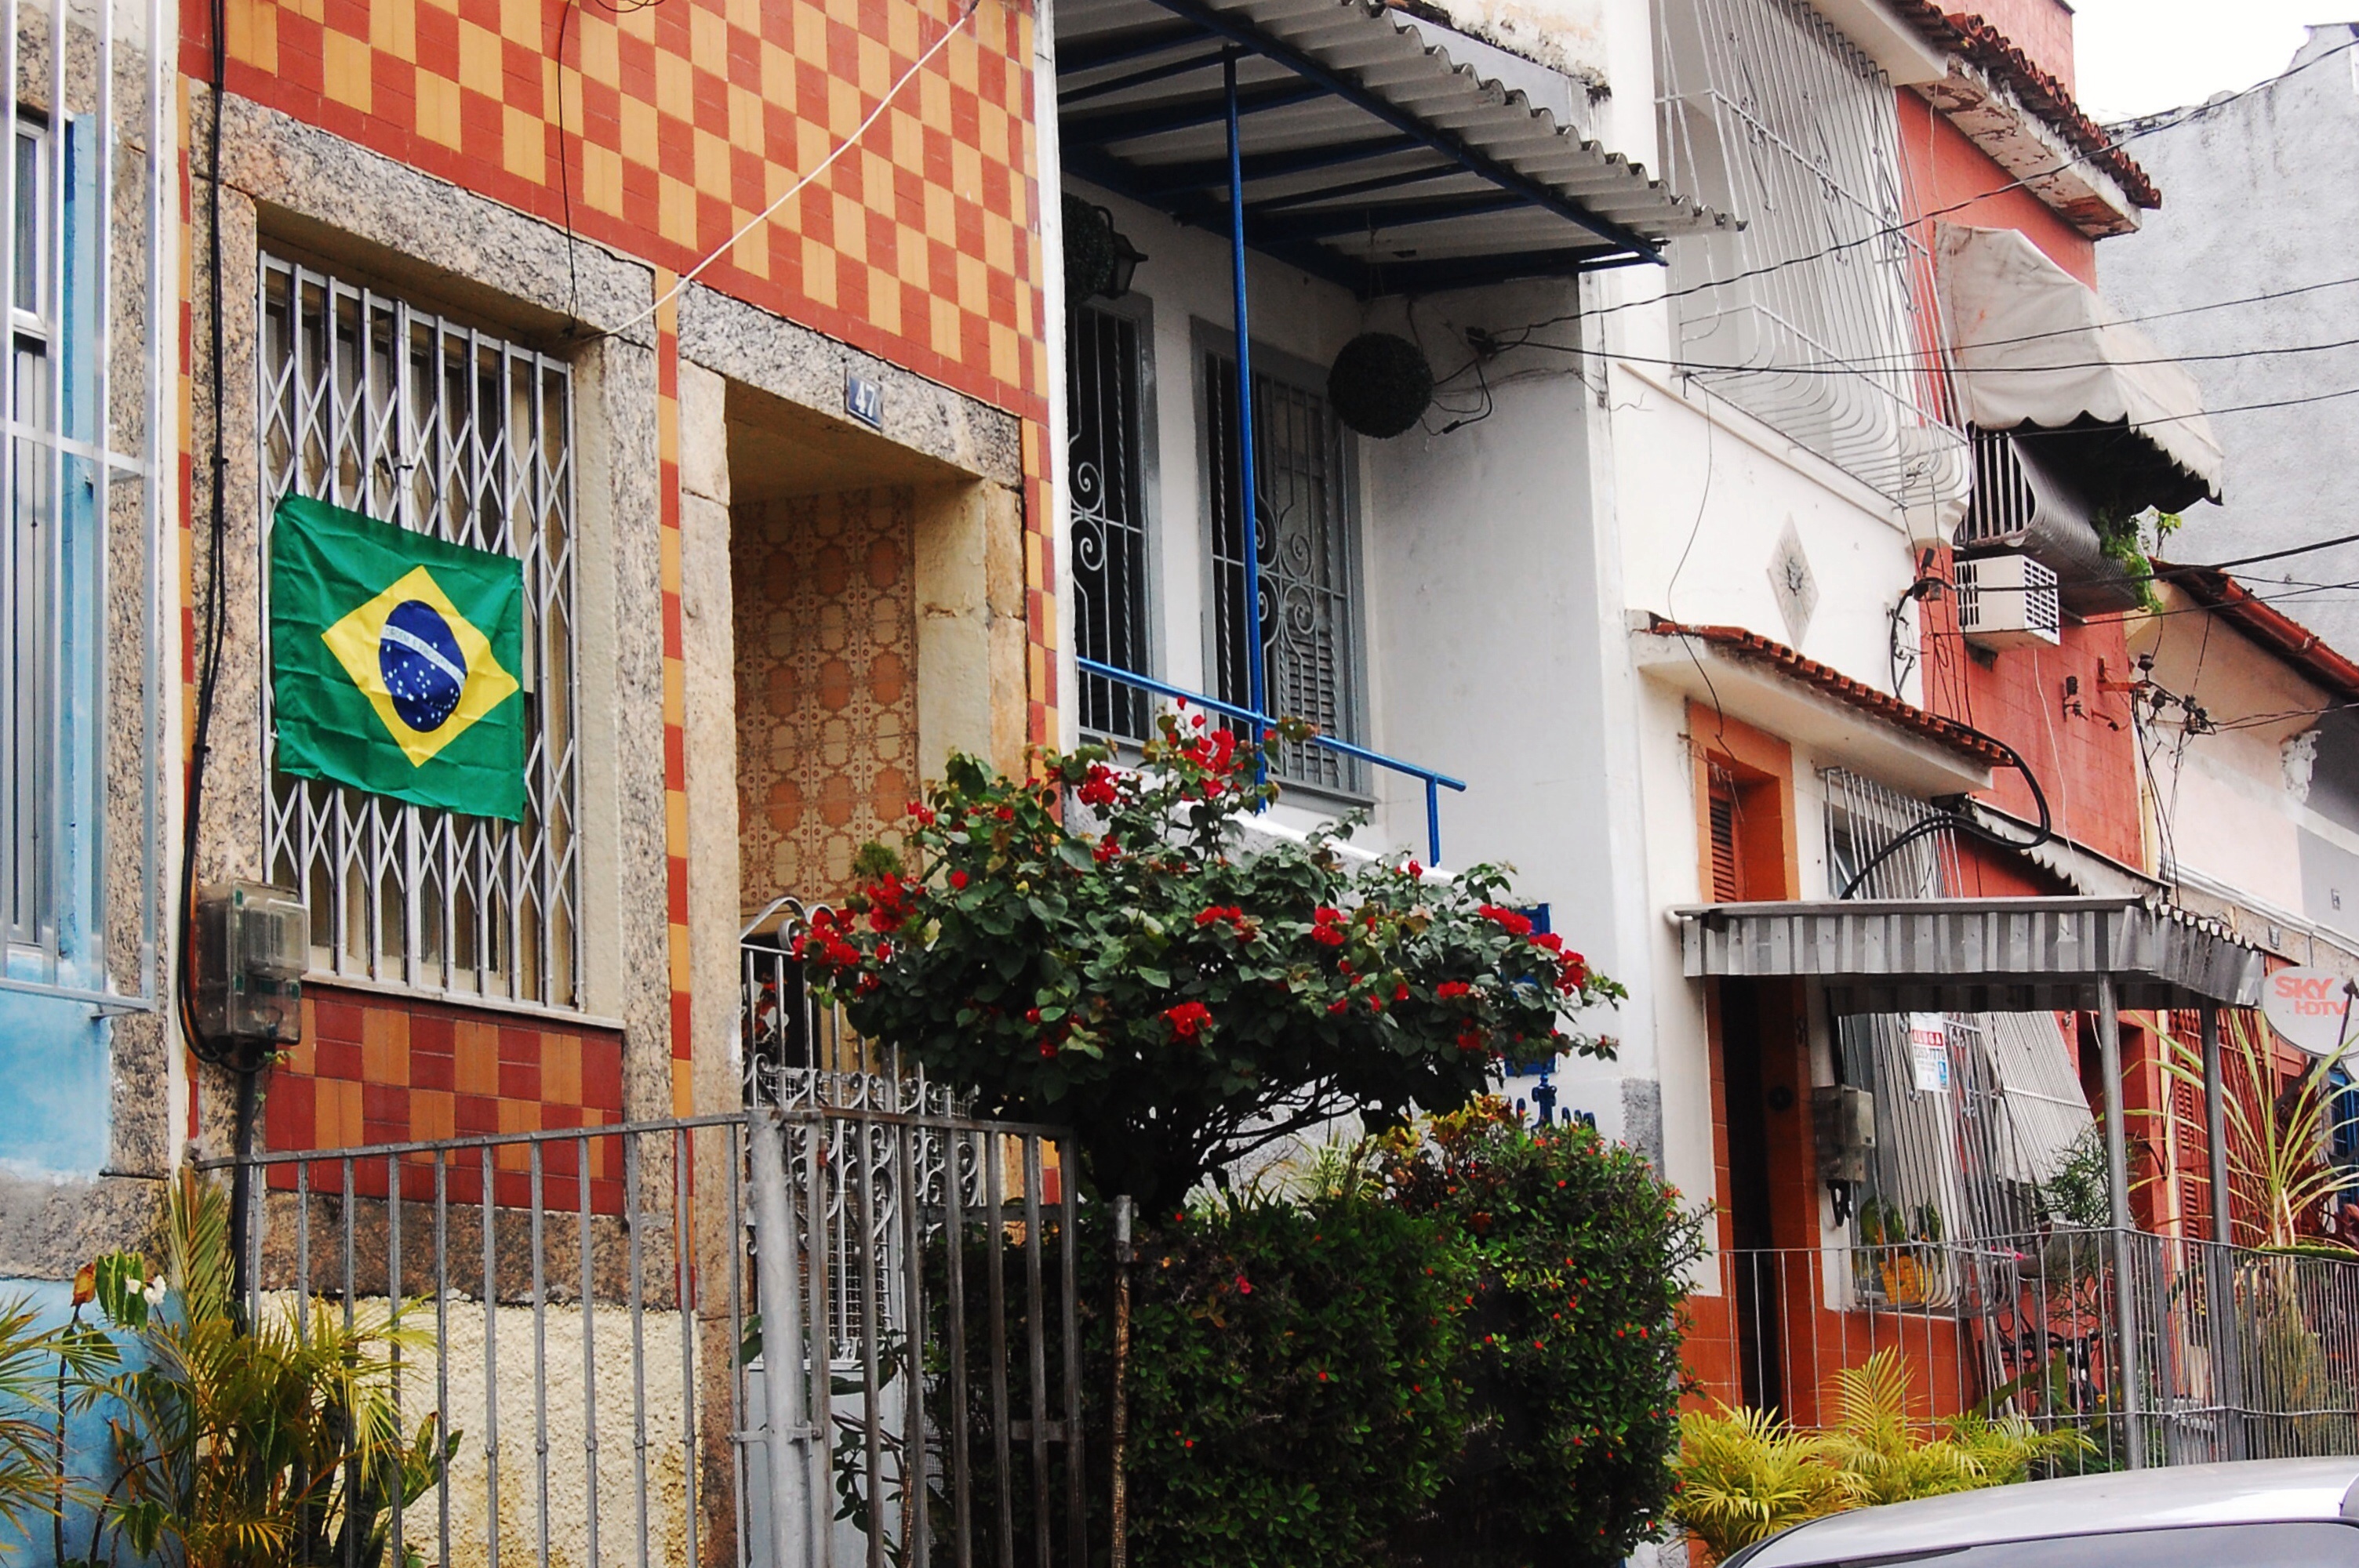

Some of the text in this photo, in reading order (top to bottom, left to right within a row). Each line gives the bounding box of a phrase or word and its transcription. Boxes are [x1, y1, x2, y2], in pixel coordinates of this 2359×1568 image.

[855, 380, 876, 418] 47
[2275, 975, 2335, 1000] SKY
[2295, 1000, 2349, 1015] HDTV
[1913, 1029, 1943, 1046] ALUGA
